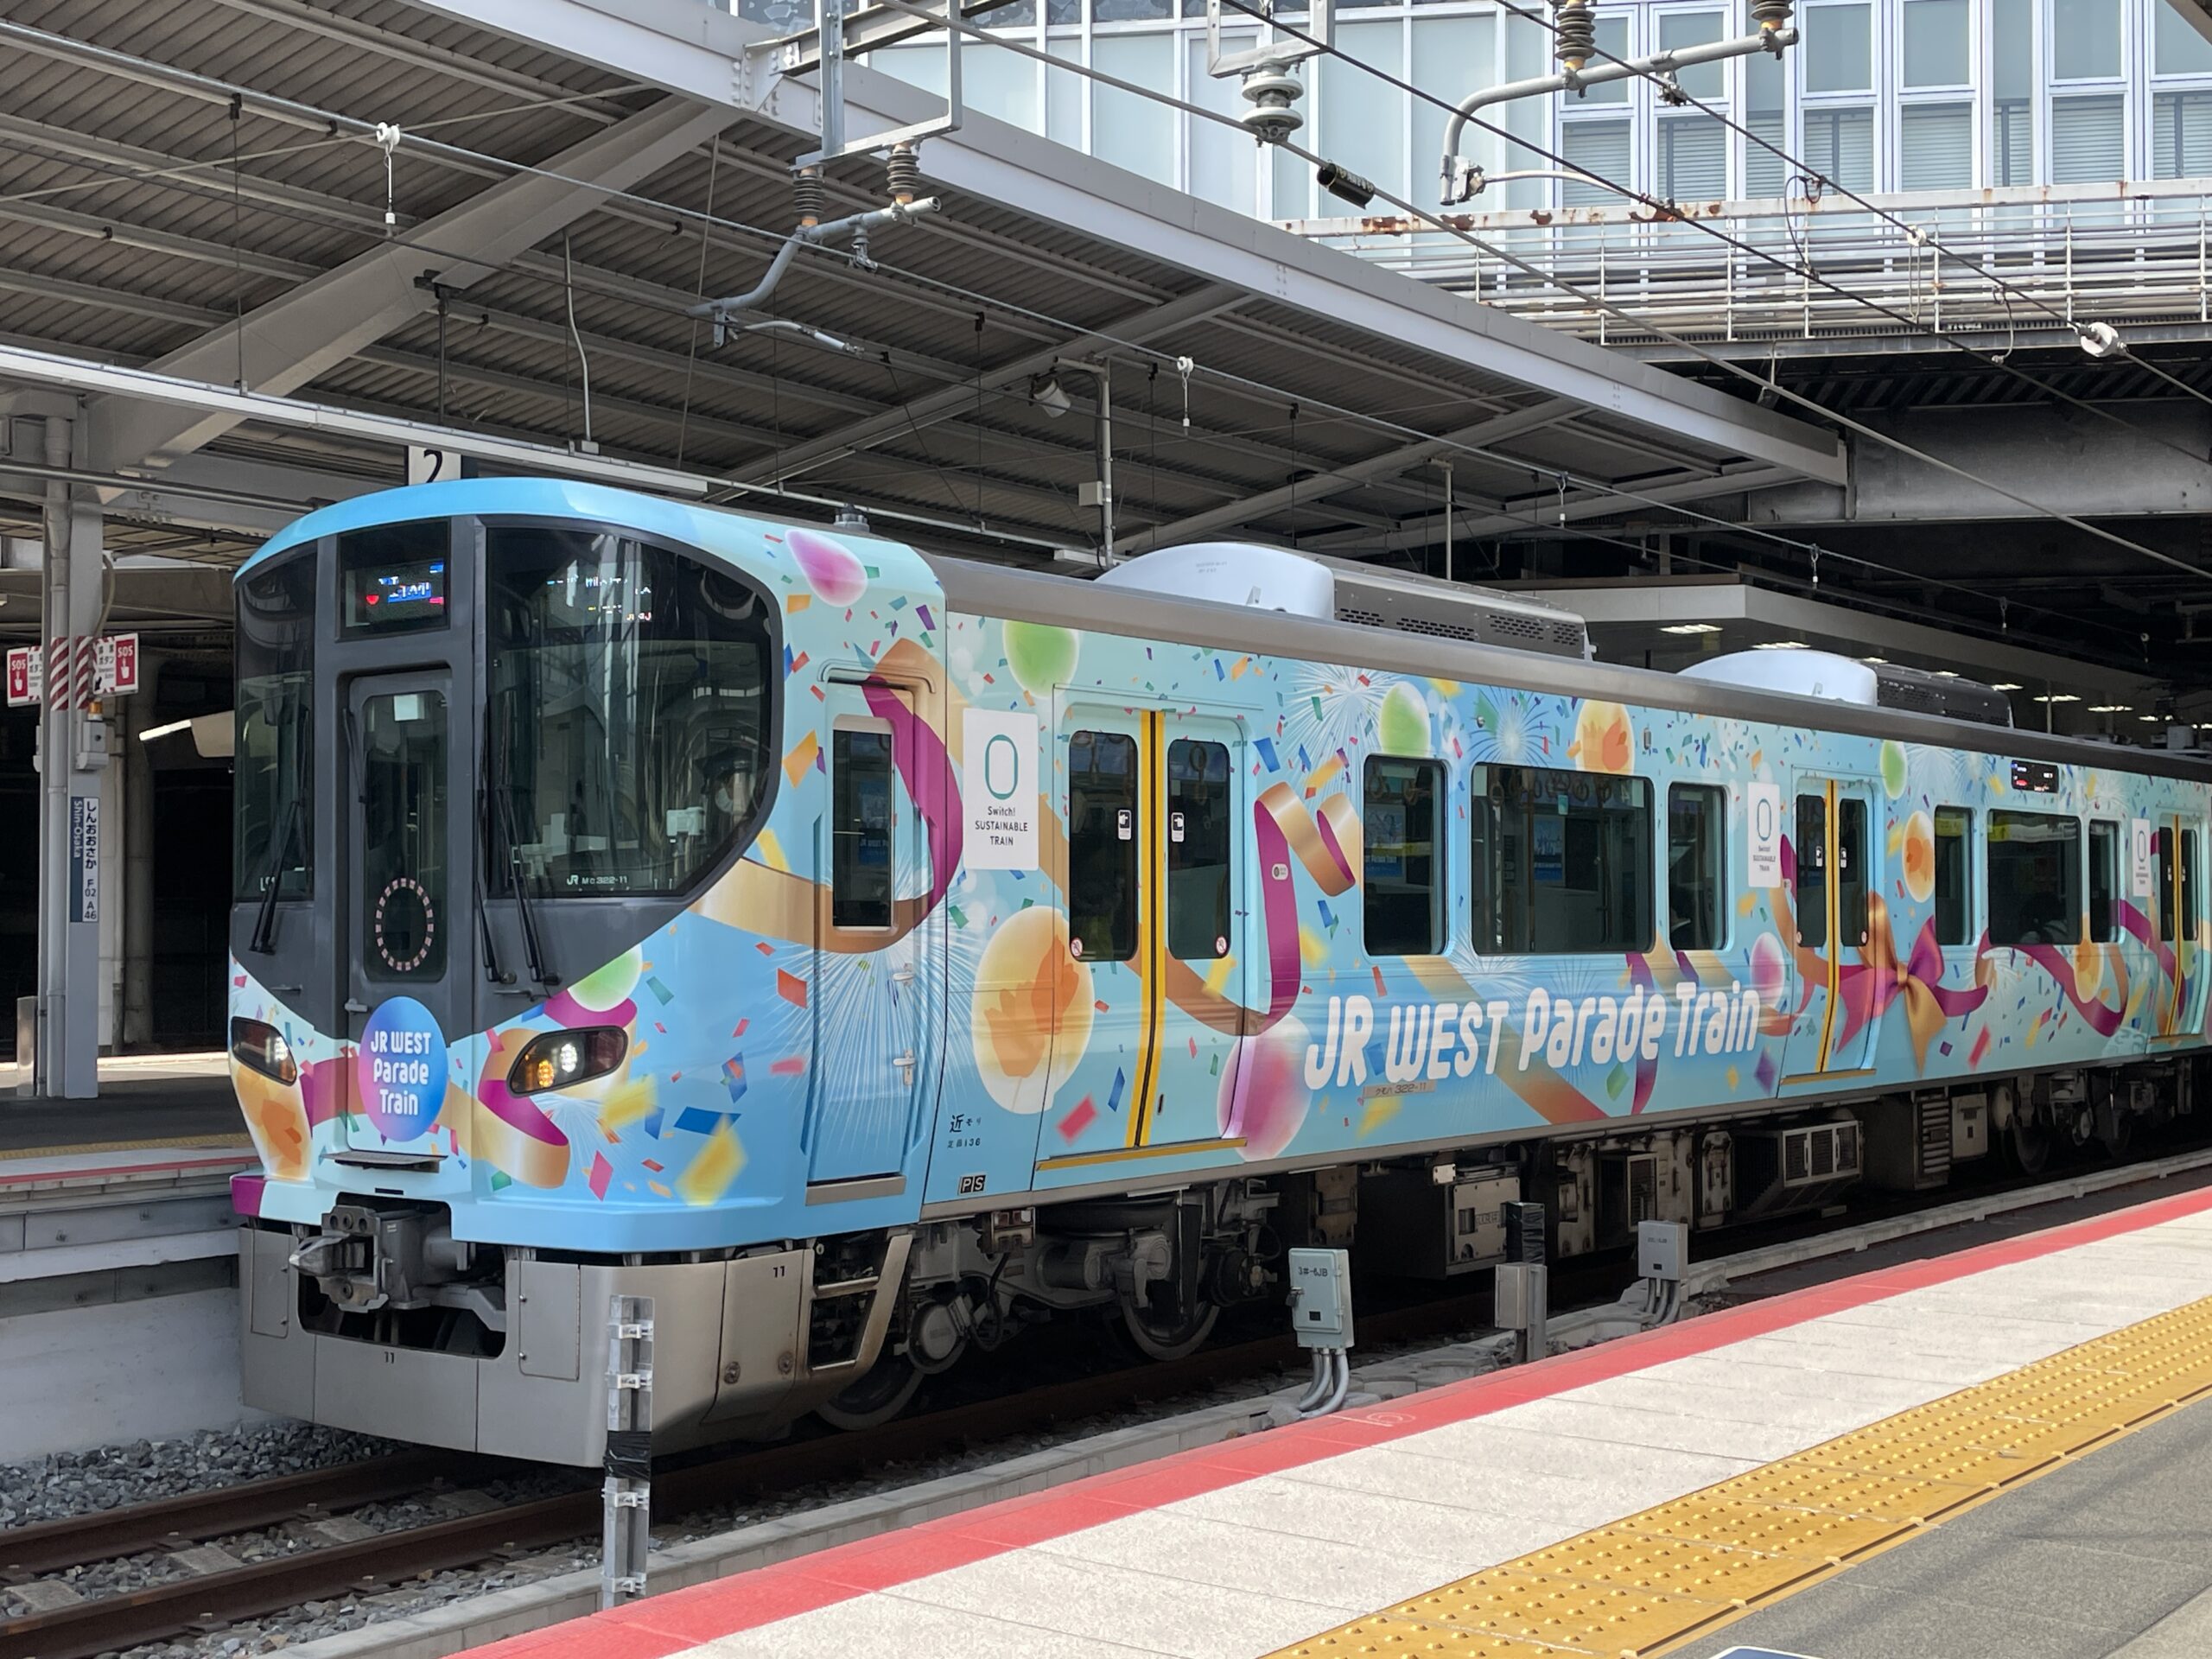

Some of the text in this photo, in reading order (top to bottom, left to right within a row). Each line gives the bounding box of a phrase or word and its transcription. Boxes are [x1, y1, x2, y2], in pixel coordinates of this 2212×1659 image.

[423, 449, 442, 483] 2
[118, 645, 133, 658] SOS
[11, 659, 26, 671] SOS
[988, 806, 1015, 817] Switch!
[73, 800, 83, 858] Shin-Osaka
[975, 820, 1028, 832] SUSTAINABLE
[86, 801, 97, 869] しんおおさか
[989, 836, 1014, 846] TRAIN
[566, 874, 579, 886] JR
[1303, 979, 1761, 1091] JR WEST Parade Train
[370, 1031, 432, 1055] JR WEST
[373, 1058, 429, 1085] Parade
[379, 1089, 419, 1116] Train
[772, 1266, 785, 1278] 11
[384, 1351, 395, 1363] 11
